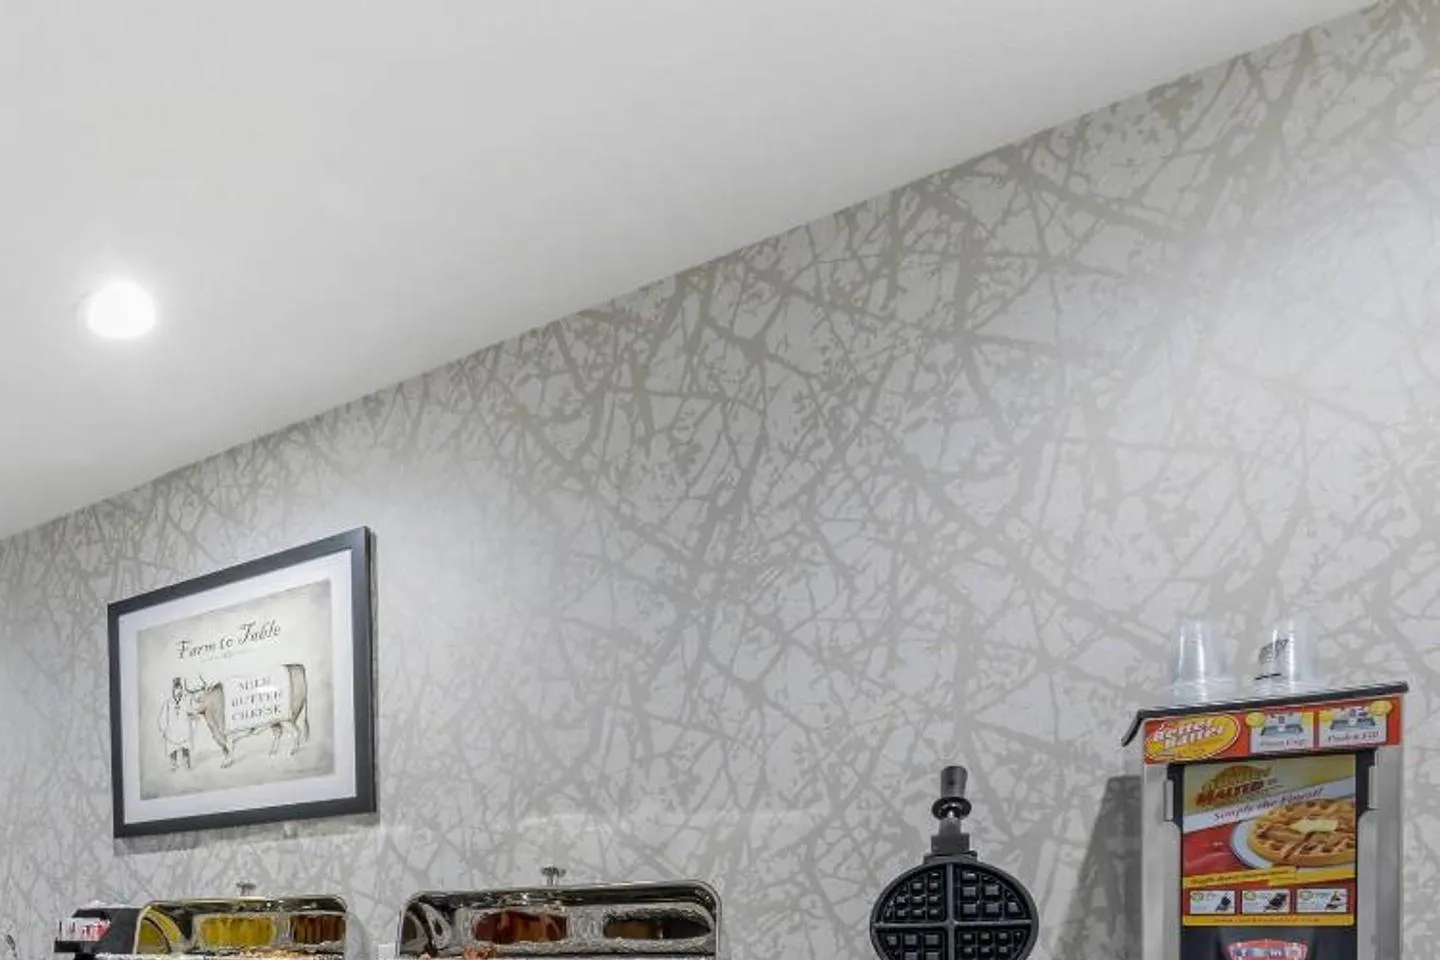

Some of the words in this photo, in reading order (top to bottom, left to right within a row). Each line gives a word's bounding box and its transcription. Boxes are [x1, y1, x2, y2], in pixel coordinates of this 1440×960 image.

[176, 640, 216, 659] Farm
[220, 638, 234, 649] to
[238, 619, 281, 645] Table
